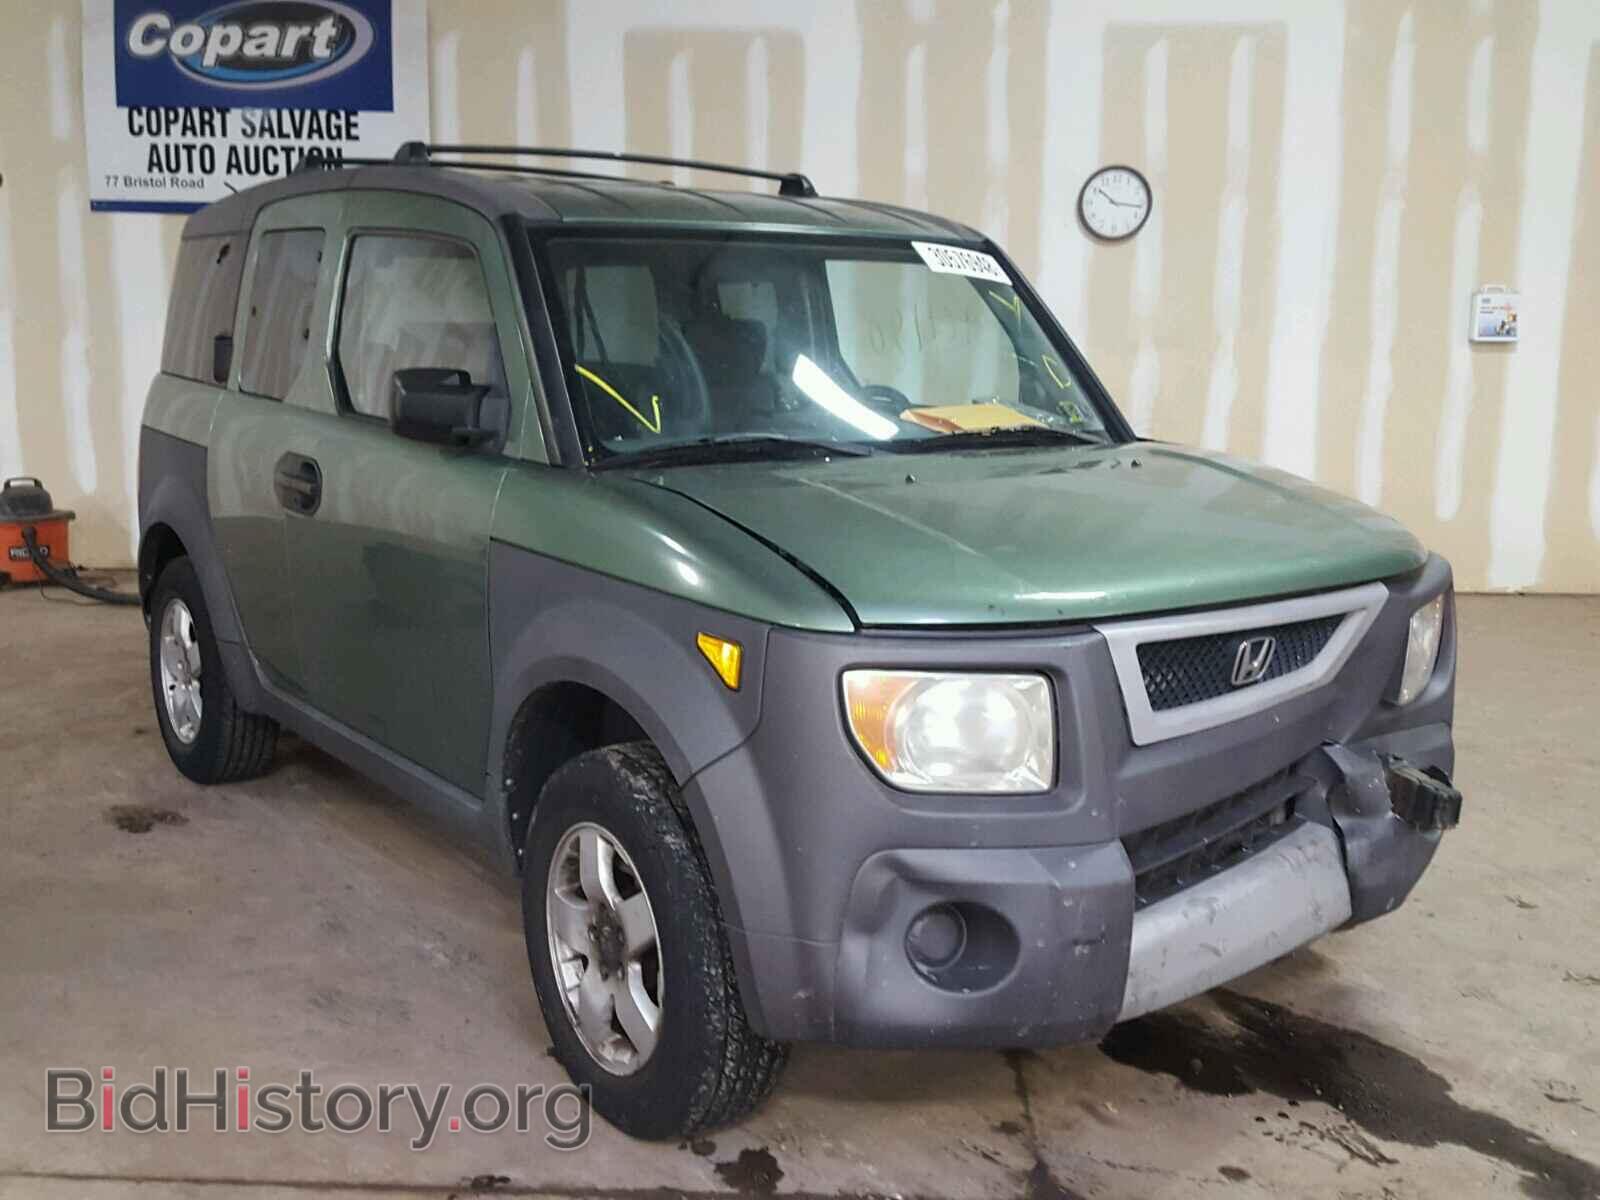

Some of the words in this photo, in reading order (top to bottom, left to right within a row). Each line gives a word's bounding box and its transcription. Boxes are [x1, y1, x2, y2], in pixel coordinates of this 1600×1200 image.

[128, 13, 338, 67] Copart
[127, 107, 231, 138] COPART
[240, 108, 360, 141] SALVAGE
[147, 143, 216, 174] AUTO
[105, 175, 120, 188] 77
[123, 176, 167, 189] Bristol
[170, 177, 205, 190] Road
